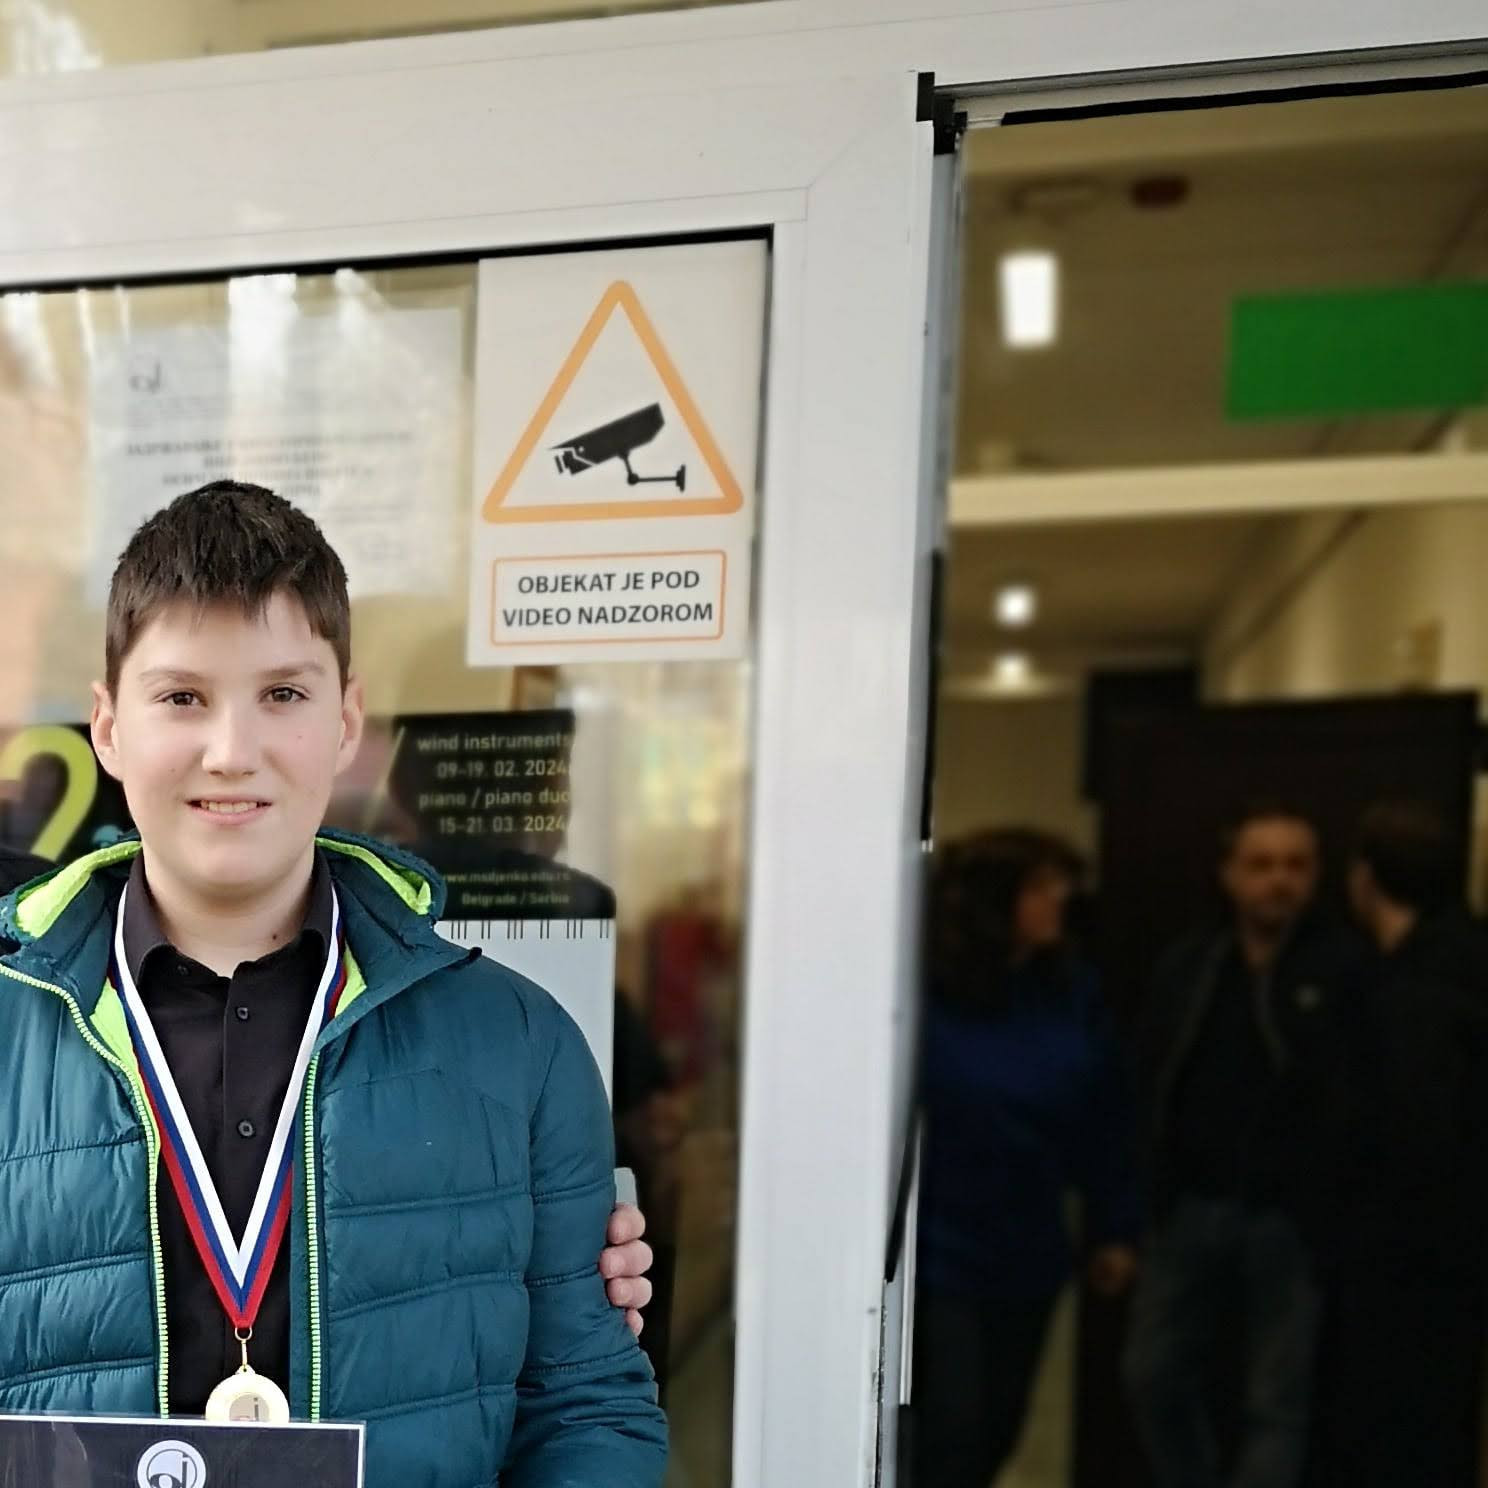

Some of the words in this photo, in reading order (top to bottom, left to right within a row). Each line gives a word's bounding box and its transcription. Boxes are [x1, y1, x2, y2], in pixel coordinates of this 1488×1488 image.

[518, 574, 616, 594] OBJEKAT
[621, 572, 644, 590] JE
[651, 570, 700, 590] POD
[503, 606, 571, 627] VIDEO
[578, 602, 713, 624] NADZOROM
[417, 734, 459, 752] wind
[525, 759, 568, 776] 2024
[418, 790, 467, 811] piano
[485, 787, 533, 808] piano
